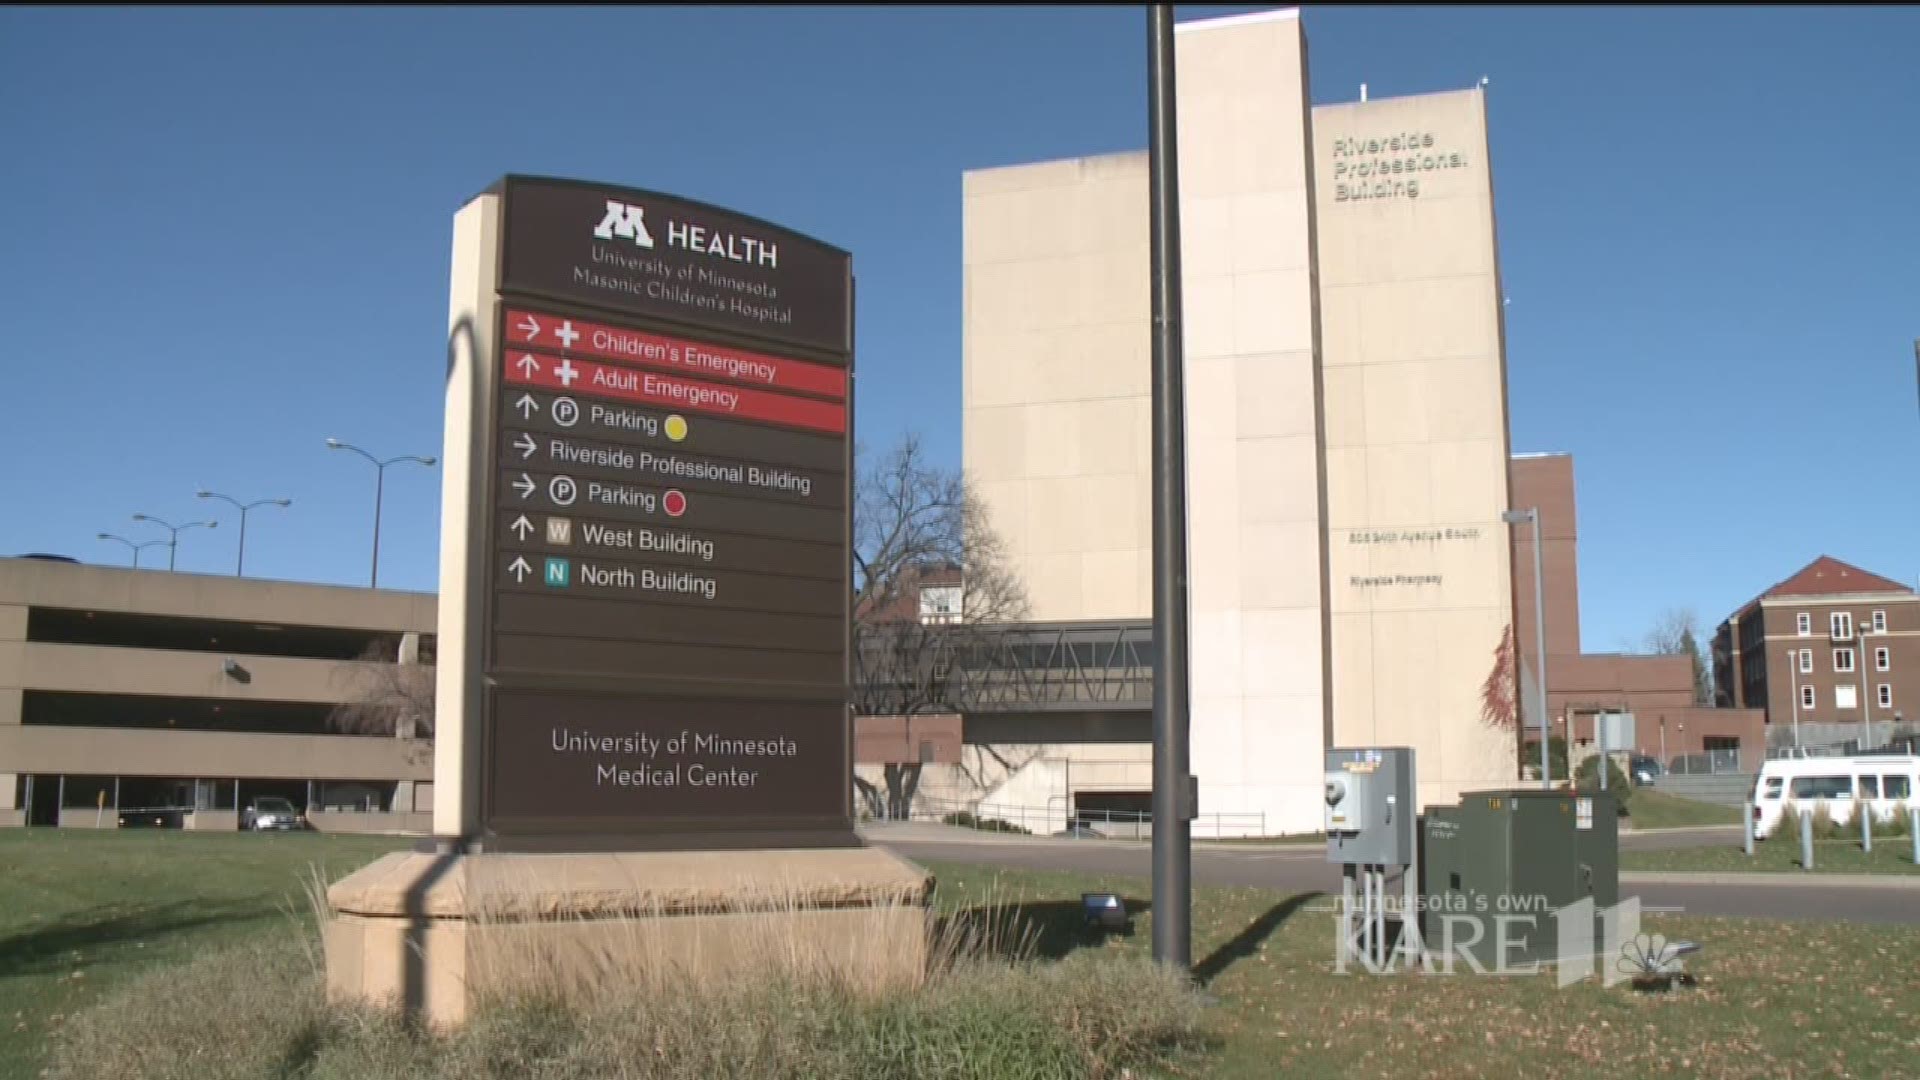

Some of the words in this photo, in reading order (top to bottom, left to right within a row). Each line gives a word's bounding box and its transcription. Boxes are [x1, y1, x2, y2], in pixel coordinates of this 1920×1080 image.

[1333, 133, 1434, 157] Riverside
[1334, 153, 1468, 179] Professional
[1334, 180, 1419, 202] Building
[667, 221, 777, 268] HEALTH
[591, 246, 671, 278] University
[677, 264, 694, 280] of
[699, 268, 777, 299] Minnesota
[574, 266, 642, 295] Masonic
[647, 281, 726, 312] Children's
[731, 299, 792, 325] Hospital
[593, 331, 679, 362] Children's
[685, 348, 776, 382] Emergency
[593, 369, 638, 392] Adult
[644, 375, 739, 408] Emergency
[591, 407, 658, 437] Parking
[551, 440, 634, 469] Riverside
[640, 454, 743, 484] Professional
[749, 468, 811, 495] Building
[588, 485, 656, 512] Parking
[549, 522, 570, 540] W
[583, 524, 633, 548] West
[640, 530, 714, 561] Building
[550, 564, 565, 581] N
[581, 564, 634, 588] North
[642, 570, 717, 599] Building
[552, 728, 660, 758] University
[667, 730, 689, 753] of
[695, 732, 798, 757] Minnesota
[596, 763, 680, 787] Medical
[687, 764, 759, 787] Center
